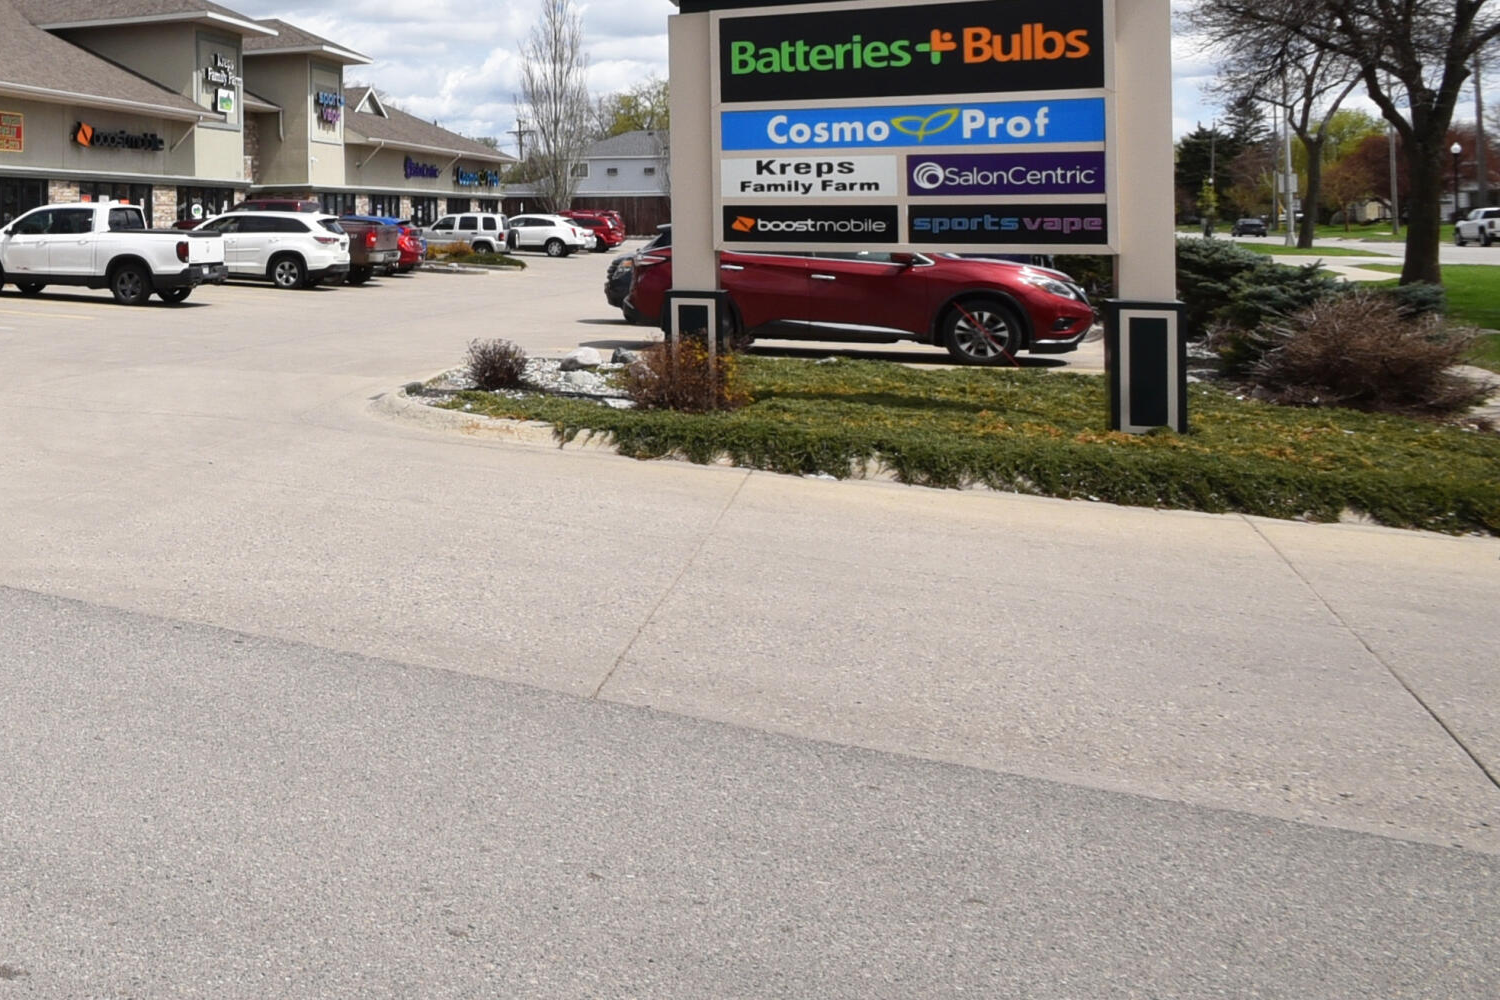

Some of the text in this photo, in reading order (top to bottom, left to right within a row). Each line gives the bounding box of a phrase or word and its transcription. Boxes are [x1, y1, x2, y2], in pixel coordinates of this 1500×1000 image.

[730, 34, 912, 75] Batteries
[962, 22, 1091, 65] Bulbs
[766, 106, 1050, 144] Cosmo Prof
[755, 159, 855, 178] Kreps
[944, 165, 1096, 186] SalonCentric
[740, 179, 880, 195] Family Farm
[757, 218, 887, 232] boostmobile
[913, 214, 1103, 234] sports vape
